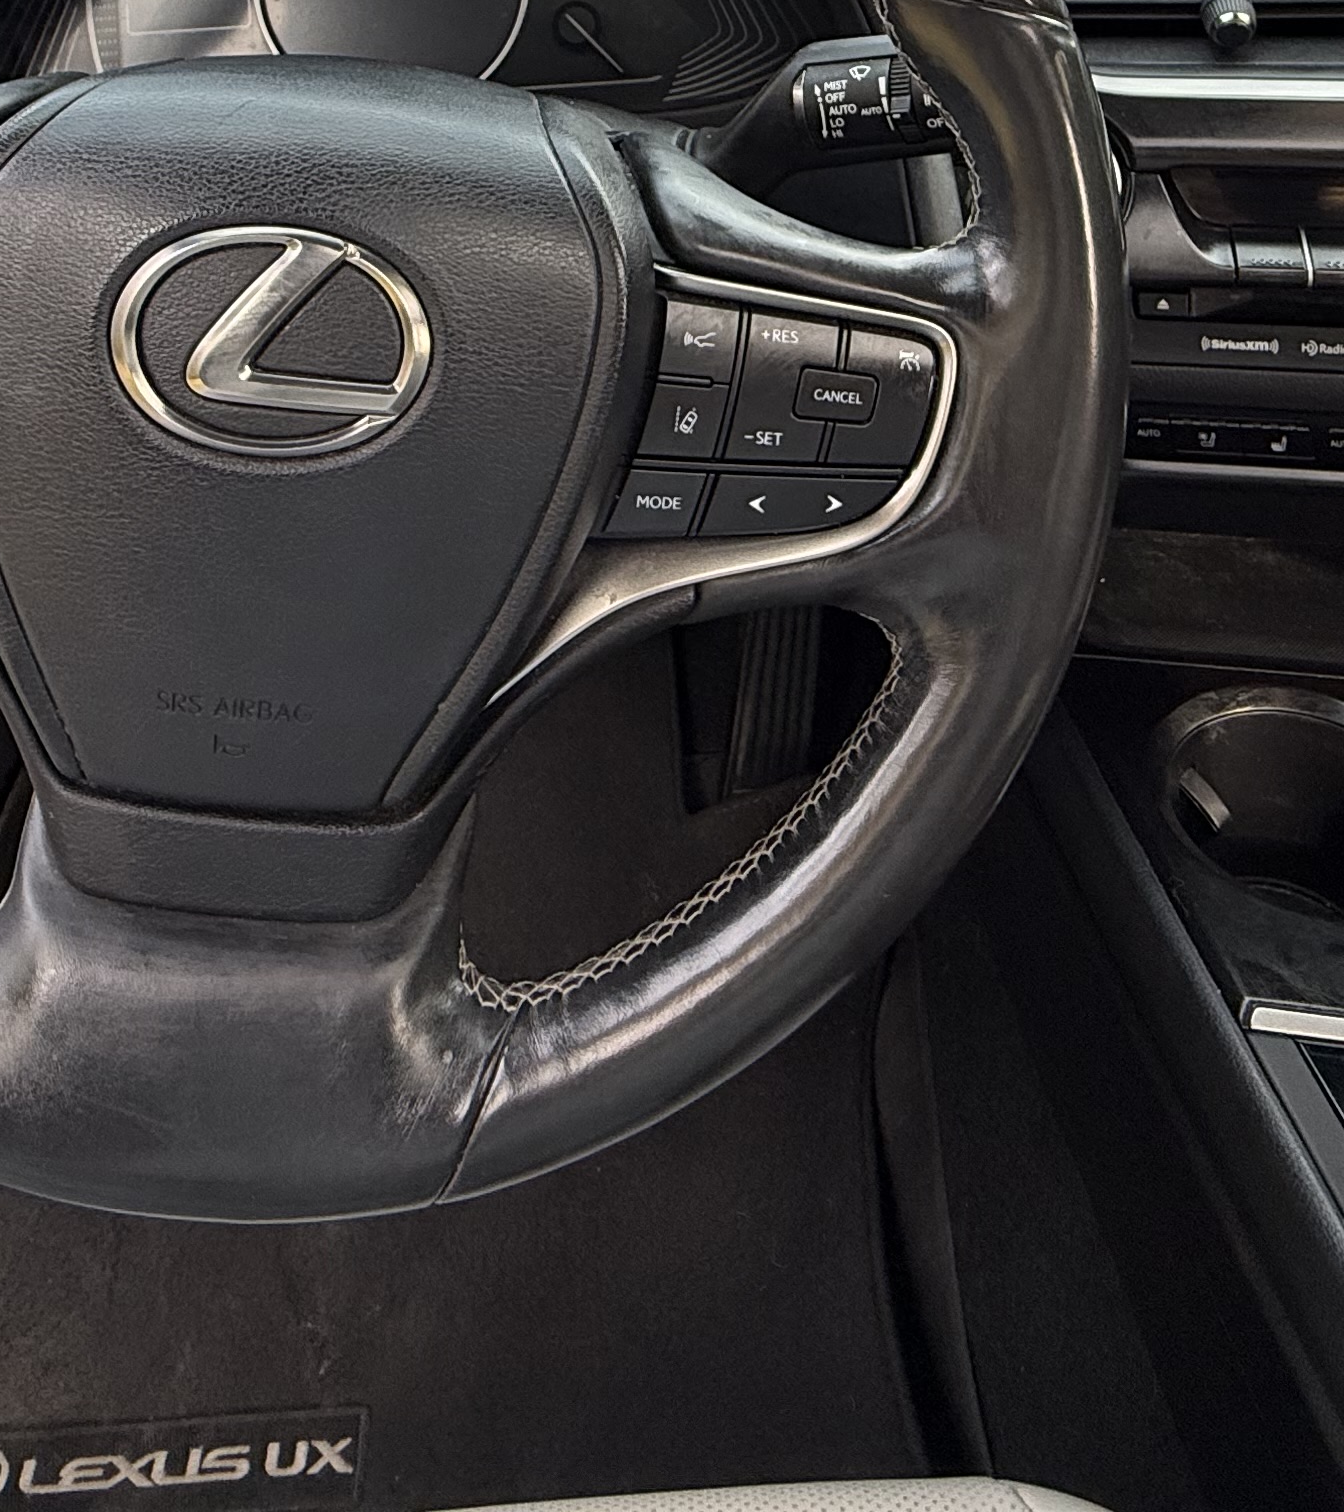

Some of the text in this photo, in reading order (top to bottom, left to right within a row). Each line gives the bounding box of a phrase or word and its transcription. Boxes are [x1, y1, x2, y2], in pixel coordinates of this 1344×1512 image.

[823, 79, 848, 92] MIST
[824, 91, 846, 104] OFF
[829, 103, 857, 116] AUTO
[860, 105, 883, 116] AUTO
[829, 117, 846, 129] LO
[831, 129, 844, 139] HI
[813, 387, 864, 406] CANCEL
[1136, 428, 1162, 439] AUTO
[635, 494, 683, 511] MODE
[156, 690, 314, 725] SRS AIRBAG
[19, 1436, 353, 1495] LEXUS UX
